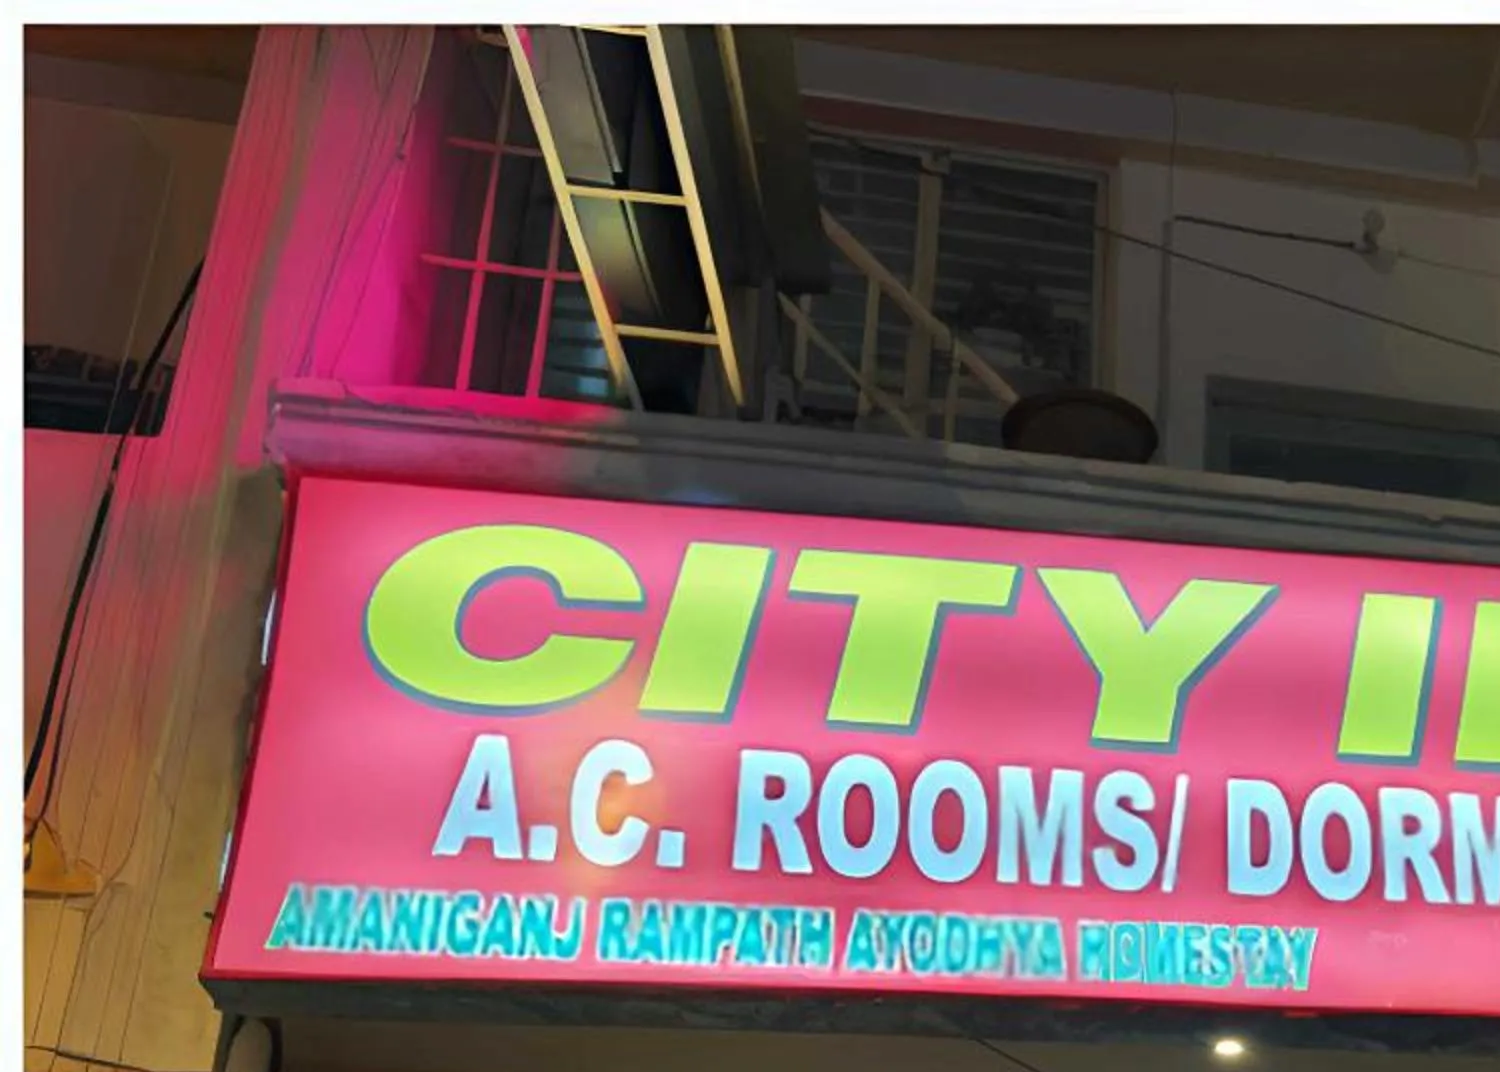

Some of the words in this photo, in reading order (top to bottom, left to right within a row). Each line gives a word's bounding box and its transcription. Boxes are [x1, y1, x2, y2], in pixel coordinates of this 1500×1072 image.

[363, 525, 1281, 755] CITY
[433, 734, 686, 868] A.C.
[264, 883, 589, 962] AMANIGANJ
[595, 896, 836, 971] RAMPATH
[843, 909, 1067, 981] AYODHYA
